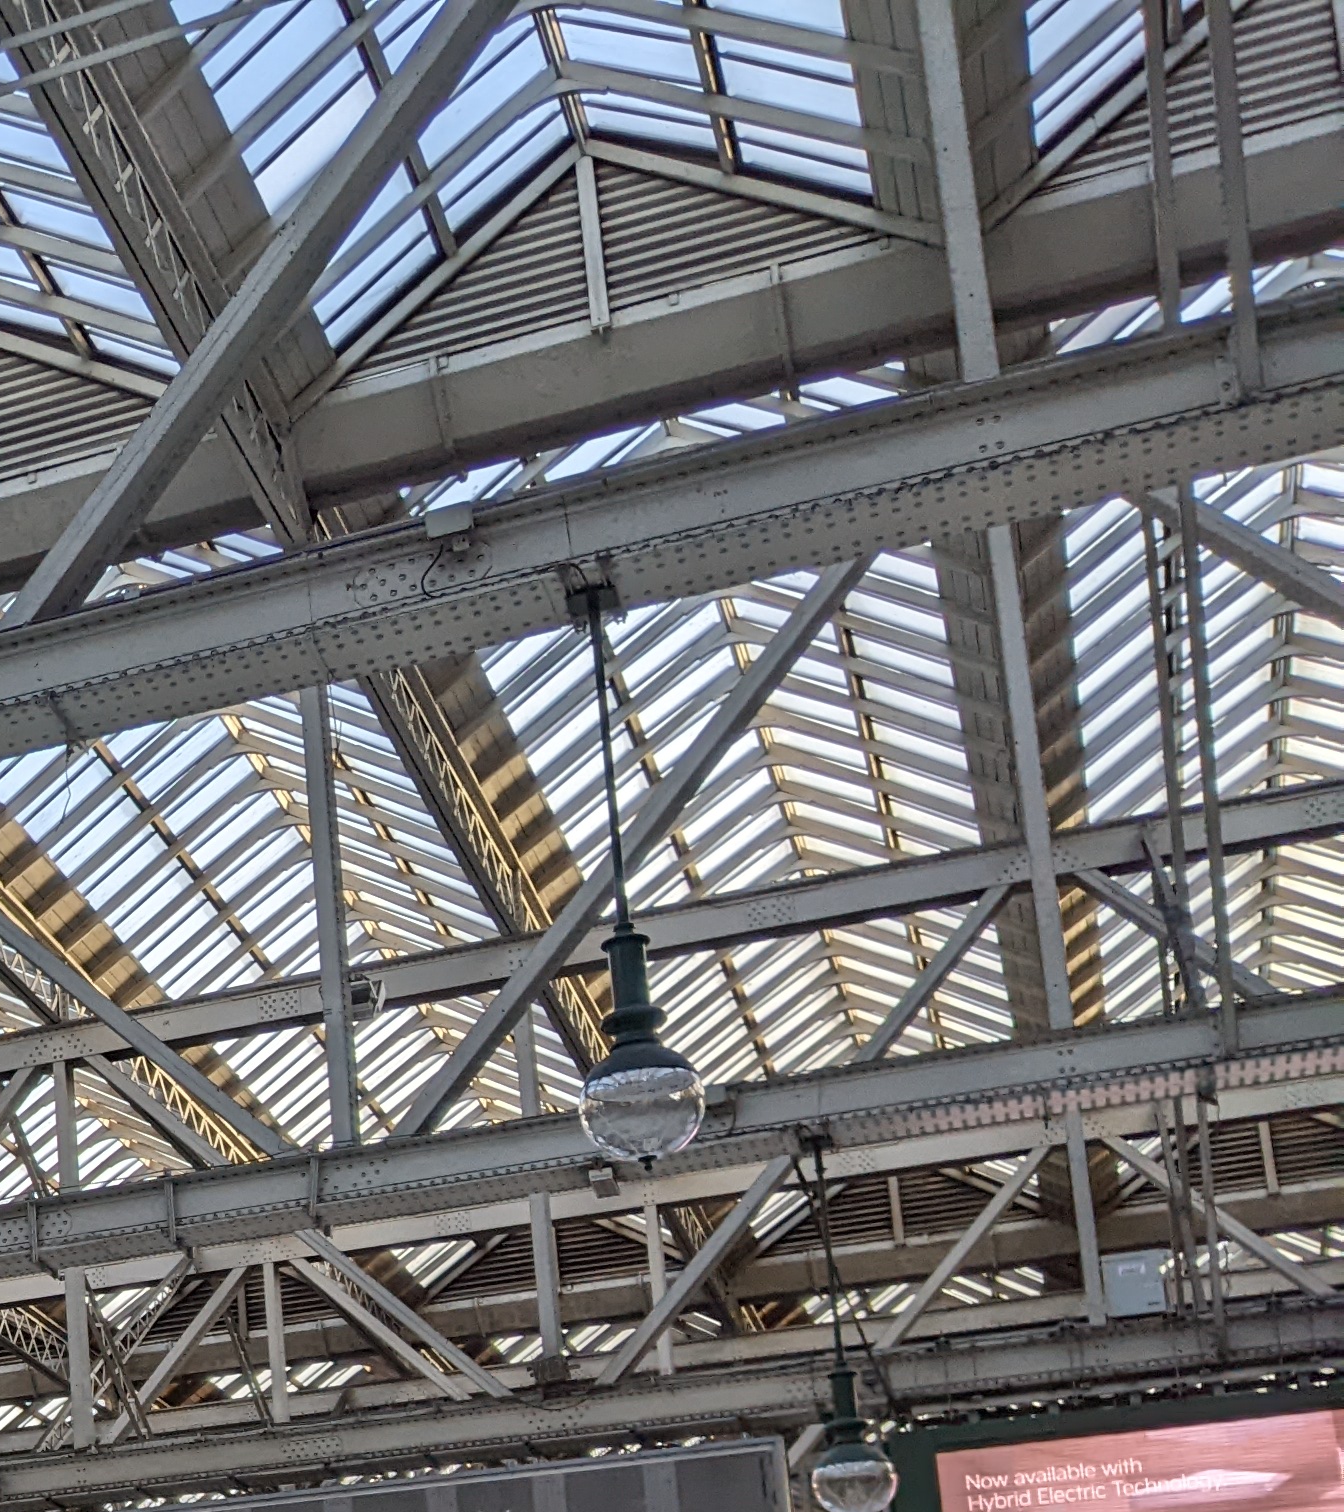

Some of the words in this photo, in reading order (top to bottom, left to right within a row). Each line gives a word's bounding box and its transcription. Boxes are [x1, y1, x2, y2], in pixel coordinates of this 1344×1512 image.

[965, 1473, 1007, 1491] Now
[1014, 1462, 1095, 1484] available
[1101, 1458, 1142, 1476] with
[967, 1490, 1031, 1512] Hybrid
[1039, 1483, 1105, 1505] Electric
